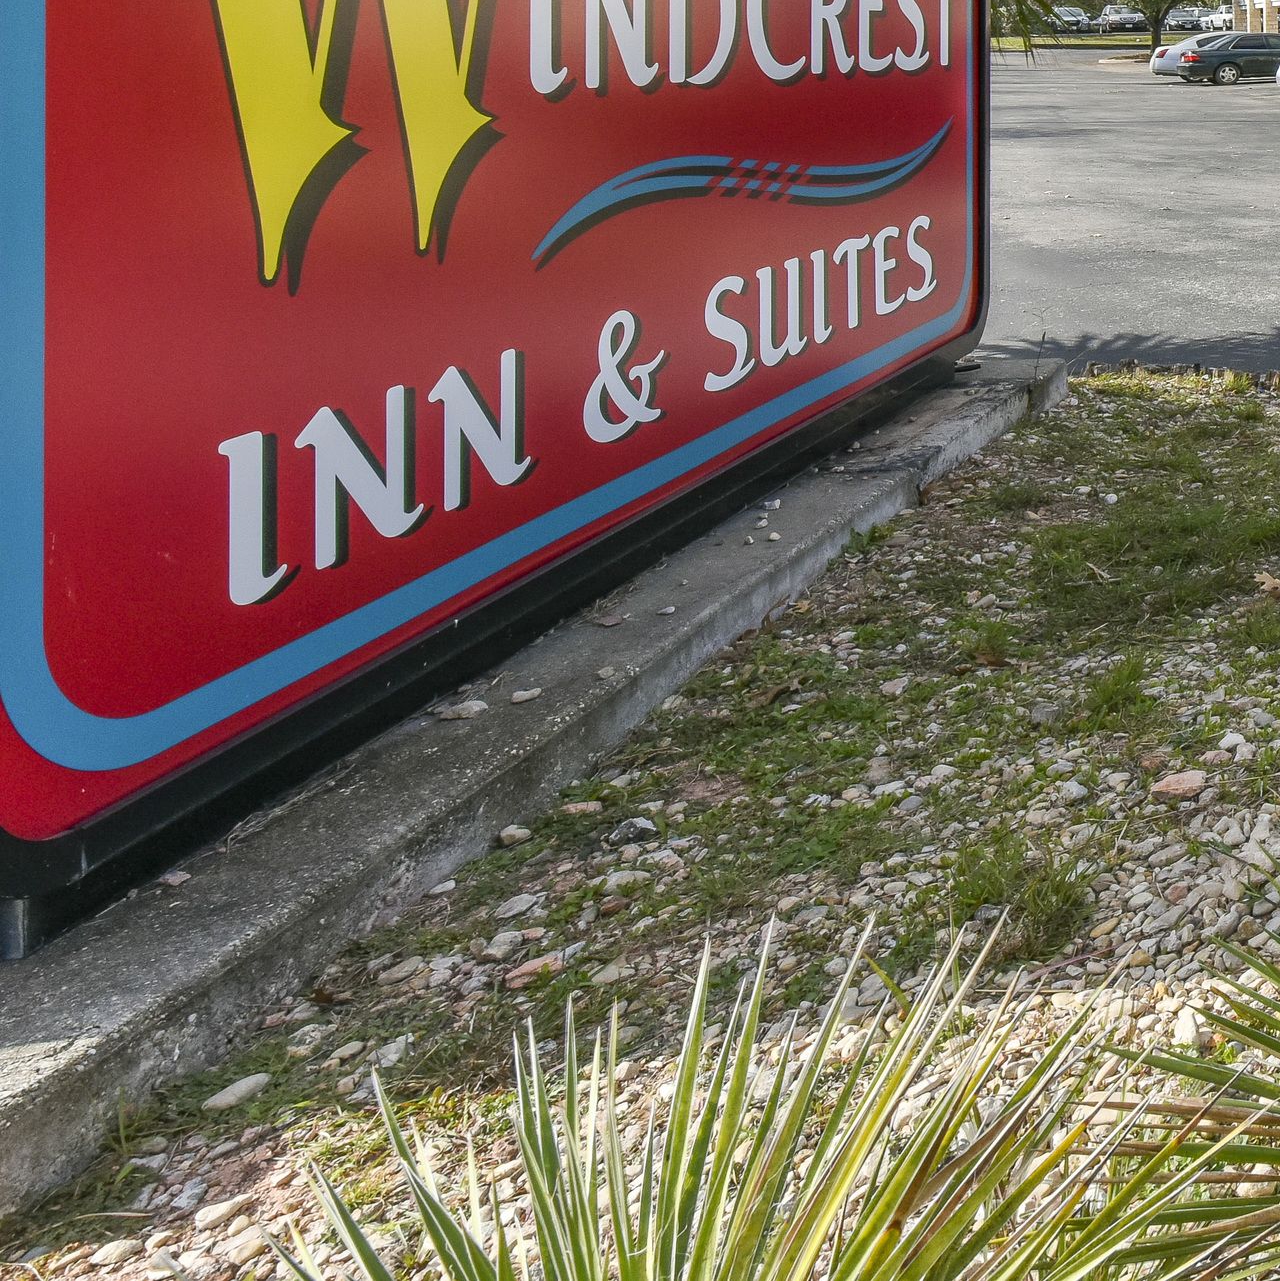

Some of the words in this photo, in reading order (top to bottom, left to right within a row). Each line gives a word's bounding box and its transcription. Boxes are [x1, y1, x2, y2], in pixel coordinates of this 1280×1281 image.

[217, 348, 532, 606] INN
[582, 309, 666, 444] &
[703, 215, 938, 393] SUITES
